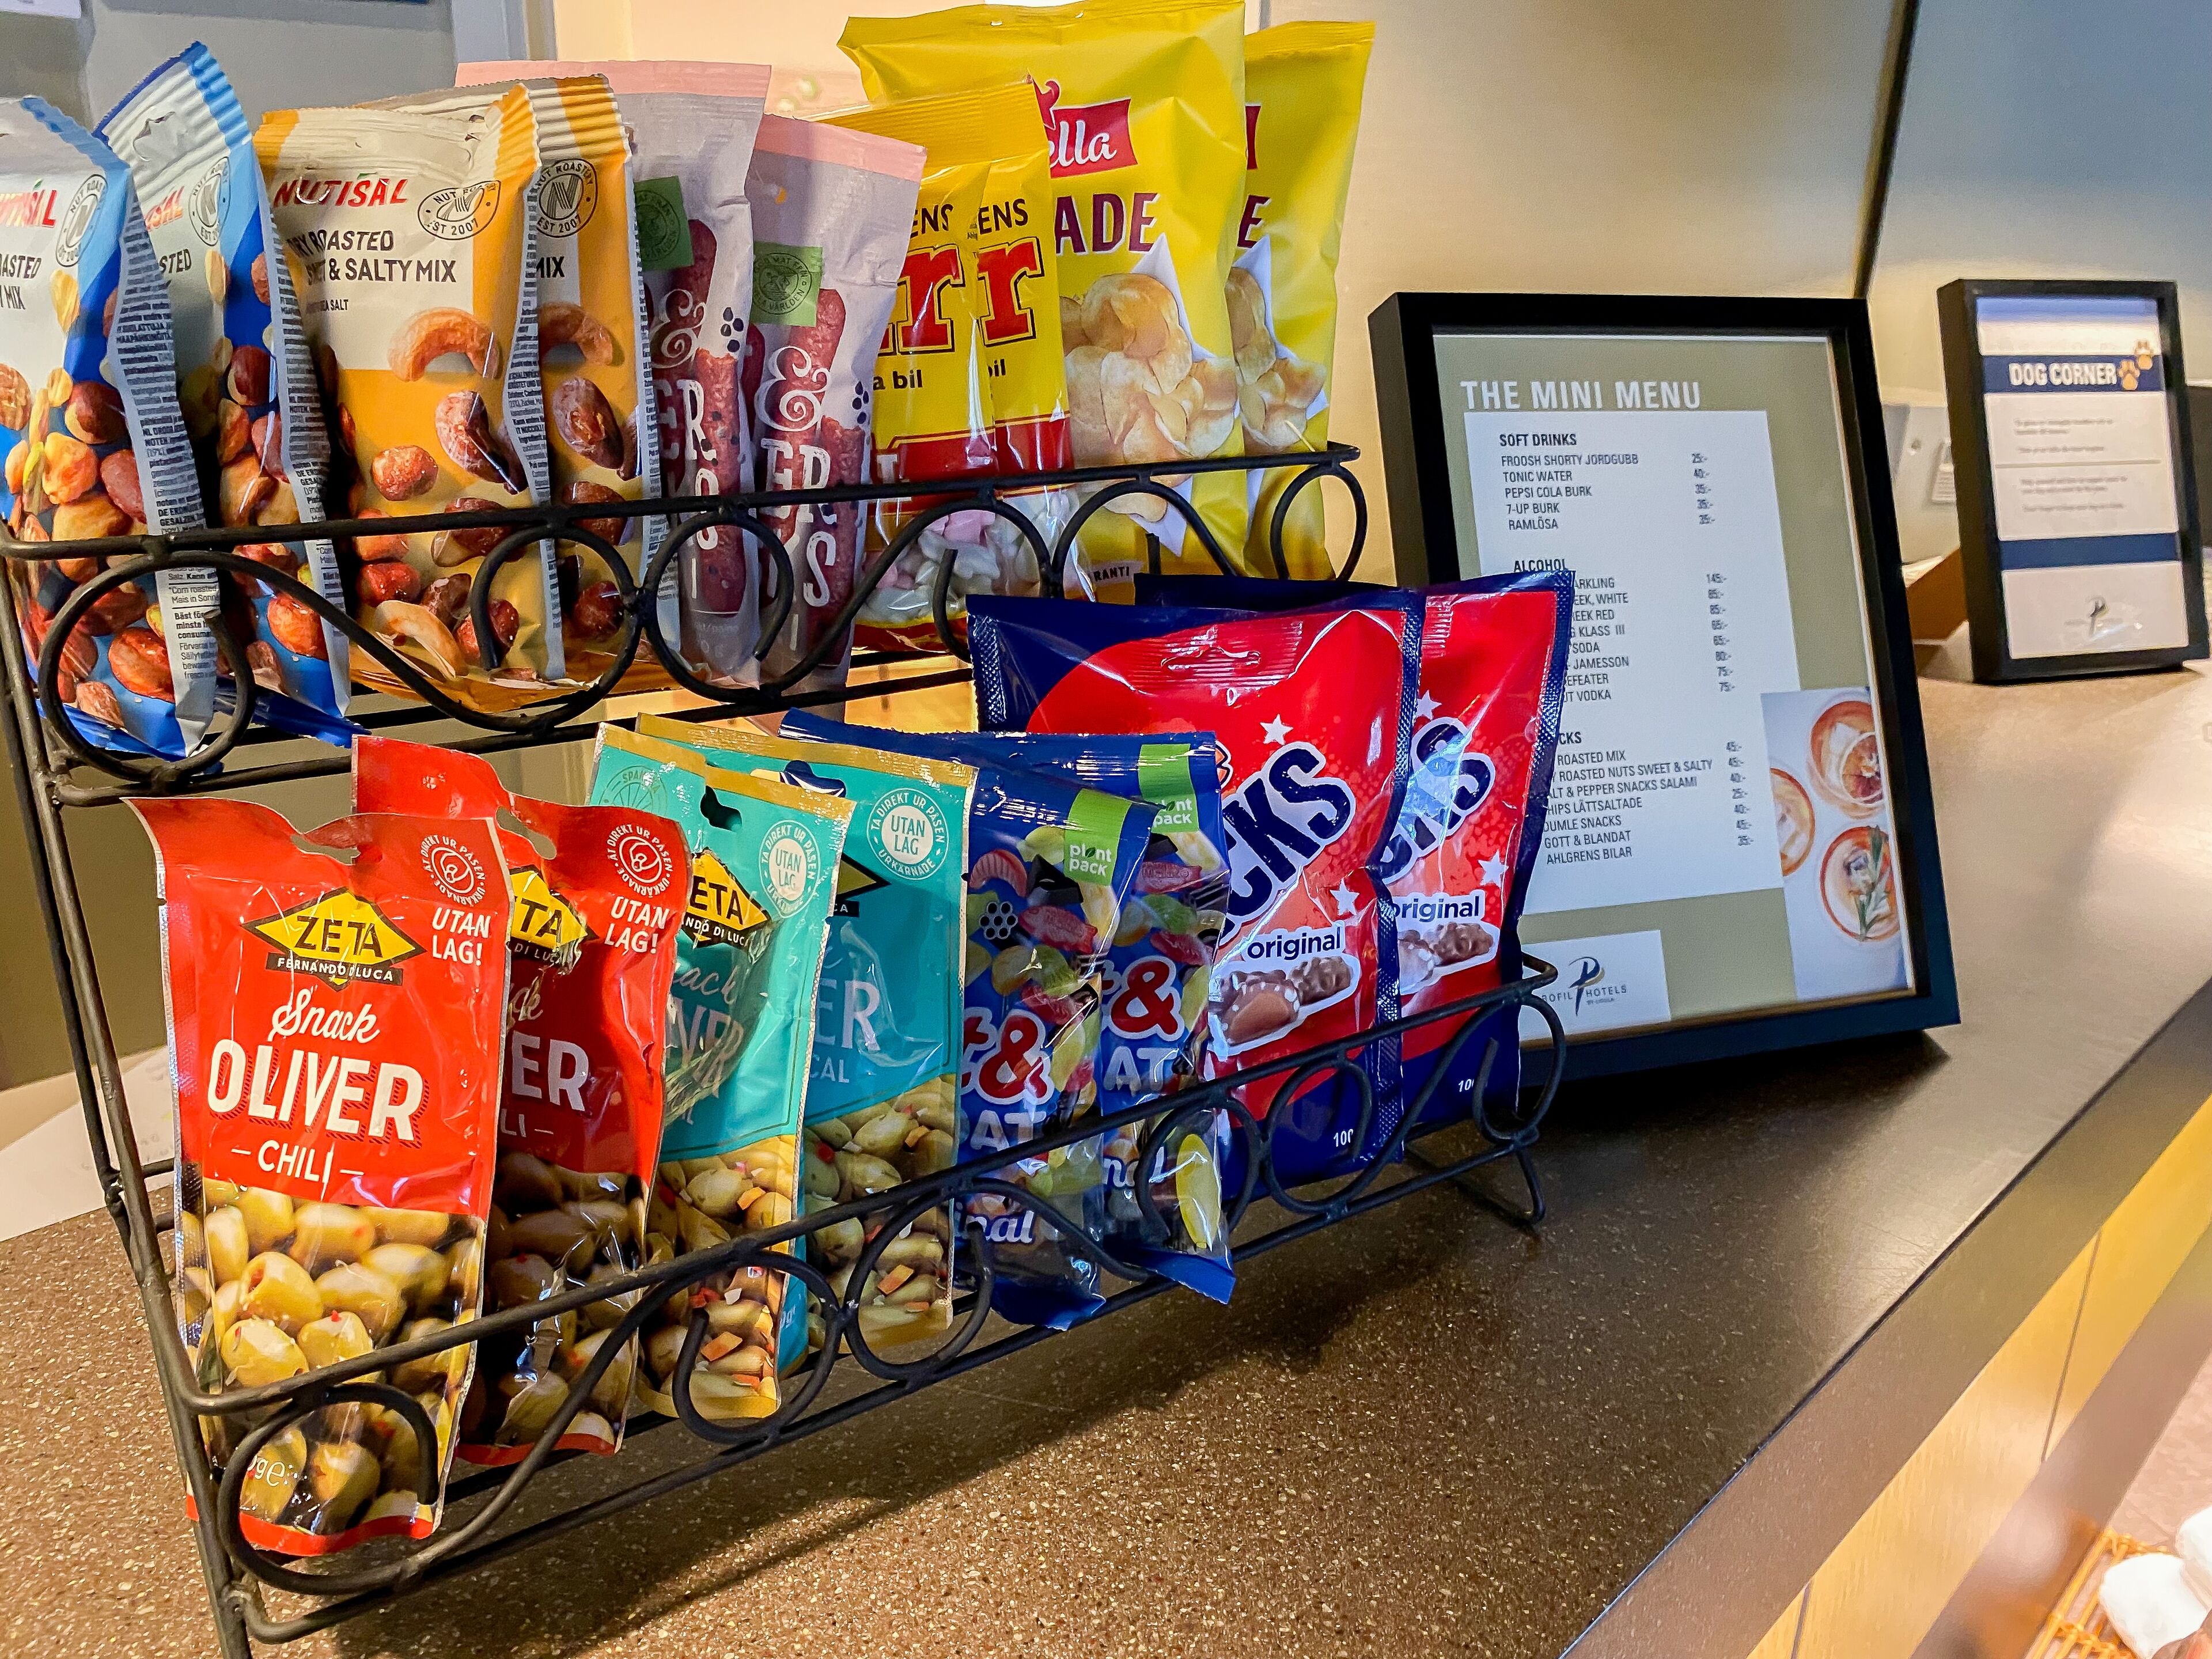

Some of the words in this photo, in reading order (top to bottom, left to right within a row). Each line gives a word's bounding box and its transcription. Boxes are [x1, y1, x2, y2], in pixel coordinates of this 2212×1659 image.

[1049, 120, 1117, 167] lla
[433, 191, 456, 204] NUT
[559, 214, 582, 233] 2007
[978, 198, 1029, 234] ENS
[1055, 192, 1158, 254] ADE
[452, 218, 479, 235] 2007
[308, 229, 394, 253] ROASTED
[329, 258, 341, 281] &
[346, 259, 412, 282] SALTY
[416, 259, 456, 282] MIX
[331, 299, 349, 310] SALT
[893, 369, 923, 389] bil
[2009, 362, 2048, 386] DOG
[2048, 362, 2118, 385] CORNER
[1460, 381, 1520, 410] THE
[1531, 381, 1603, 410] MINI
[1614, 381, 1700, 409] MENU
[1499, 434, 1529, 447] SOFT
[1532, 433, 1577, 446] DRINKS
[1501, 454, 1541, 467] FROOSH
[1544, 454, 1582, 466] SHORTY
[1503, 471, 1535, 483] TONIC
[1536, 470, 1573, 482] WATER
[1505, 487, 1535, 499] PEPSI
[1536, 486, 1563, 498] COLA
[1565, 486, 1593, 497] BURK
[1506, 503, 1530, 514] 7-UP
[1532, 502, 1560, 514] BURK
[1509, 518, 1559, 531] RAMLÖSA
[1089, 566, 1129, 582] RANTI
[1514, 559, 1567, 573] ALCOHOL
[1597, 593, 1628, 605] WHITE
[1596, 609, 1615, 620] RED
[1579, 625, 1611, 637] KLASS
[1573, 656, 1629, 669] JAMESSON
[1577, 690, 1612, 702] VODKA
[1559, 732, 1582, 745] CKS
[1557, 752, 1604, 766] ROASTED
[1606, 750, 1627, 761] MIX
[1559, 768, 1605, 781] ROASTED
[1608, 766, 1635, 778] NUTS
[1637, 763, 1671, 776] SWEET
[1683, 759, 1713, 772] SALTY
[1567, 786, 1574, 797] &
[1577, 783, 1615, 797] PEPPER
[1617, 780, 1657, 794] SNACKS
[1573, 797, 1642, 813] LÄTTSALTADE
[877, 793, 909, 817] DIREKT
[913, 794, 926, 809] UR
[925, 805, 945, 843] PÅSEN
[891, 815, 926, 838] UTAN
[1153, 813, 1192, 827] pack
[1543, 819, 1578, 832] DUMLE
[1581, 816, 1622, 829] SNACKS
[442, 835, 457, 849] UR
[607, 824, 633, 846] DIREKT
[636, 825, 650, 839] UR
[765, 824, 792, 850] DIREKT
[794, 827, 806, 843] UR
[895, 834, 919, 855] LAG
[1221, 748, 1351, 927] CKS
[1544, 835, 1570, 849] GOTT
[1574, 835, 1581, 846] &
[1584, 830, 1631, 844] BLANDAT
[775, 848, 802, 873] UTAN
[1547, 850, 1600, 865] AHLGRENS
[1603, 846, 1633, 860] BILAR
[1069, 856, 1107, 877] pack
[516, 896, 562, 941] TA
[611, 896, 670, 930] UTAN
[433, 908, 491, 939] UTAN
[682, 916, 710, 932] NDO
[713, 926, 724, 938] DI
[294, 915, 383, 957] ZETA
[604, 923, 658, 955] LAG!
[1248, 927, 1341, 961] original
[432, 934, 483, 965] LAG!
[514, 943, 528, 954] DI
[355, 967, 393, 982] LUCA
[674, 965, 740, 1005] ack
[1586, 984, 1627, 997] HOTELS
[1111, 959, 1181, 1040] &
[268, 987, 381, 1043] Snack
[207, 1039, 426, 1143] OLIVER
[258, 1140, 334, 1184] CHILI
